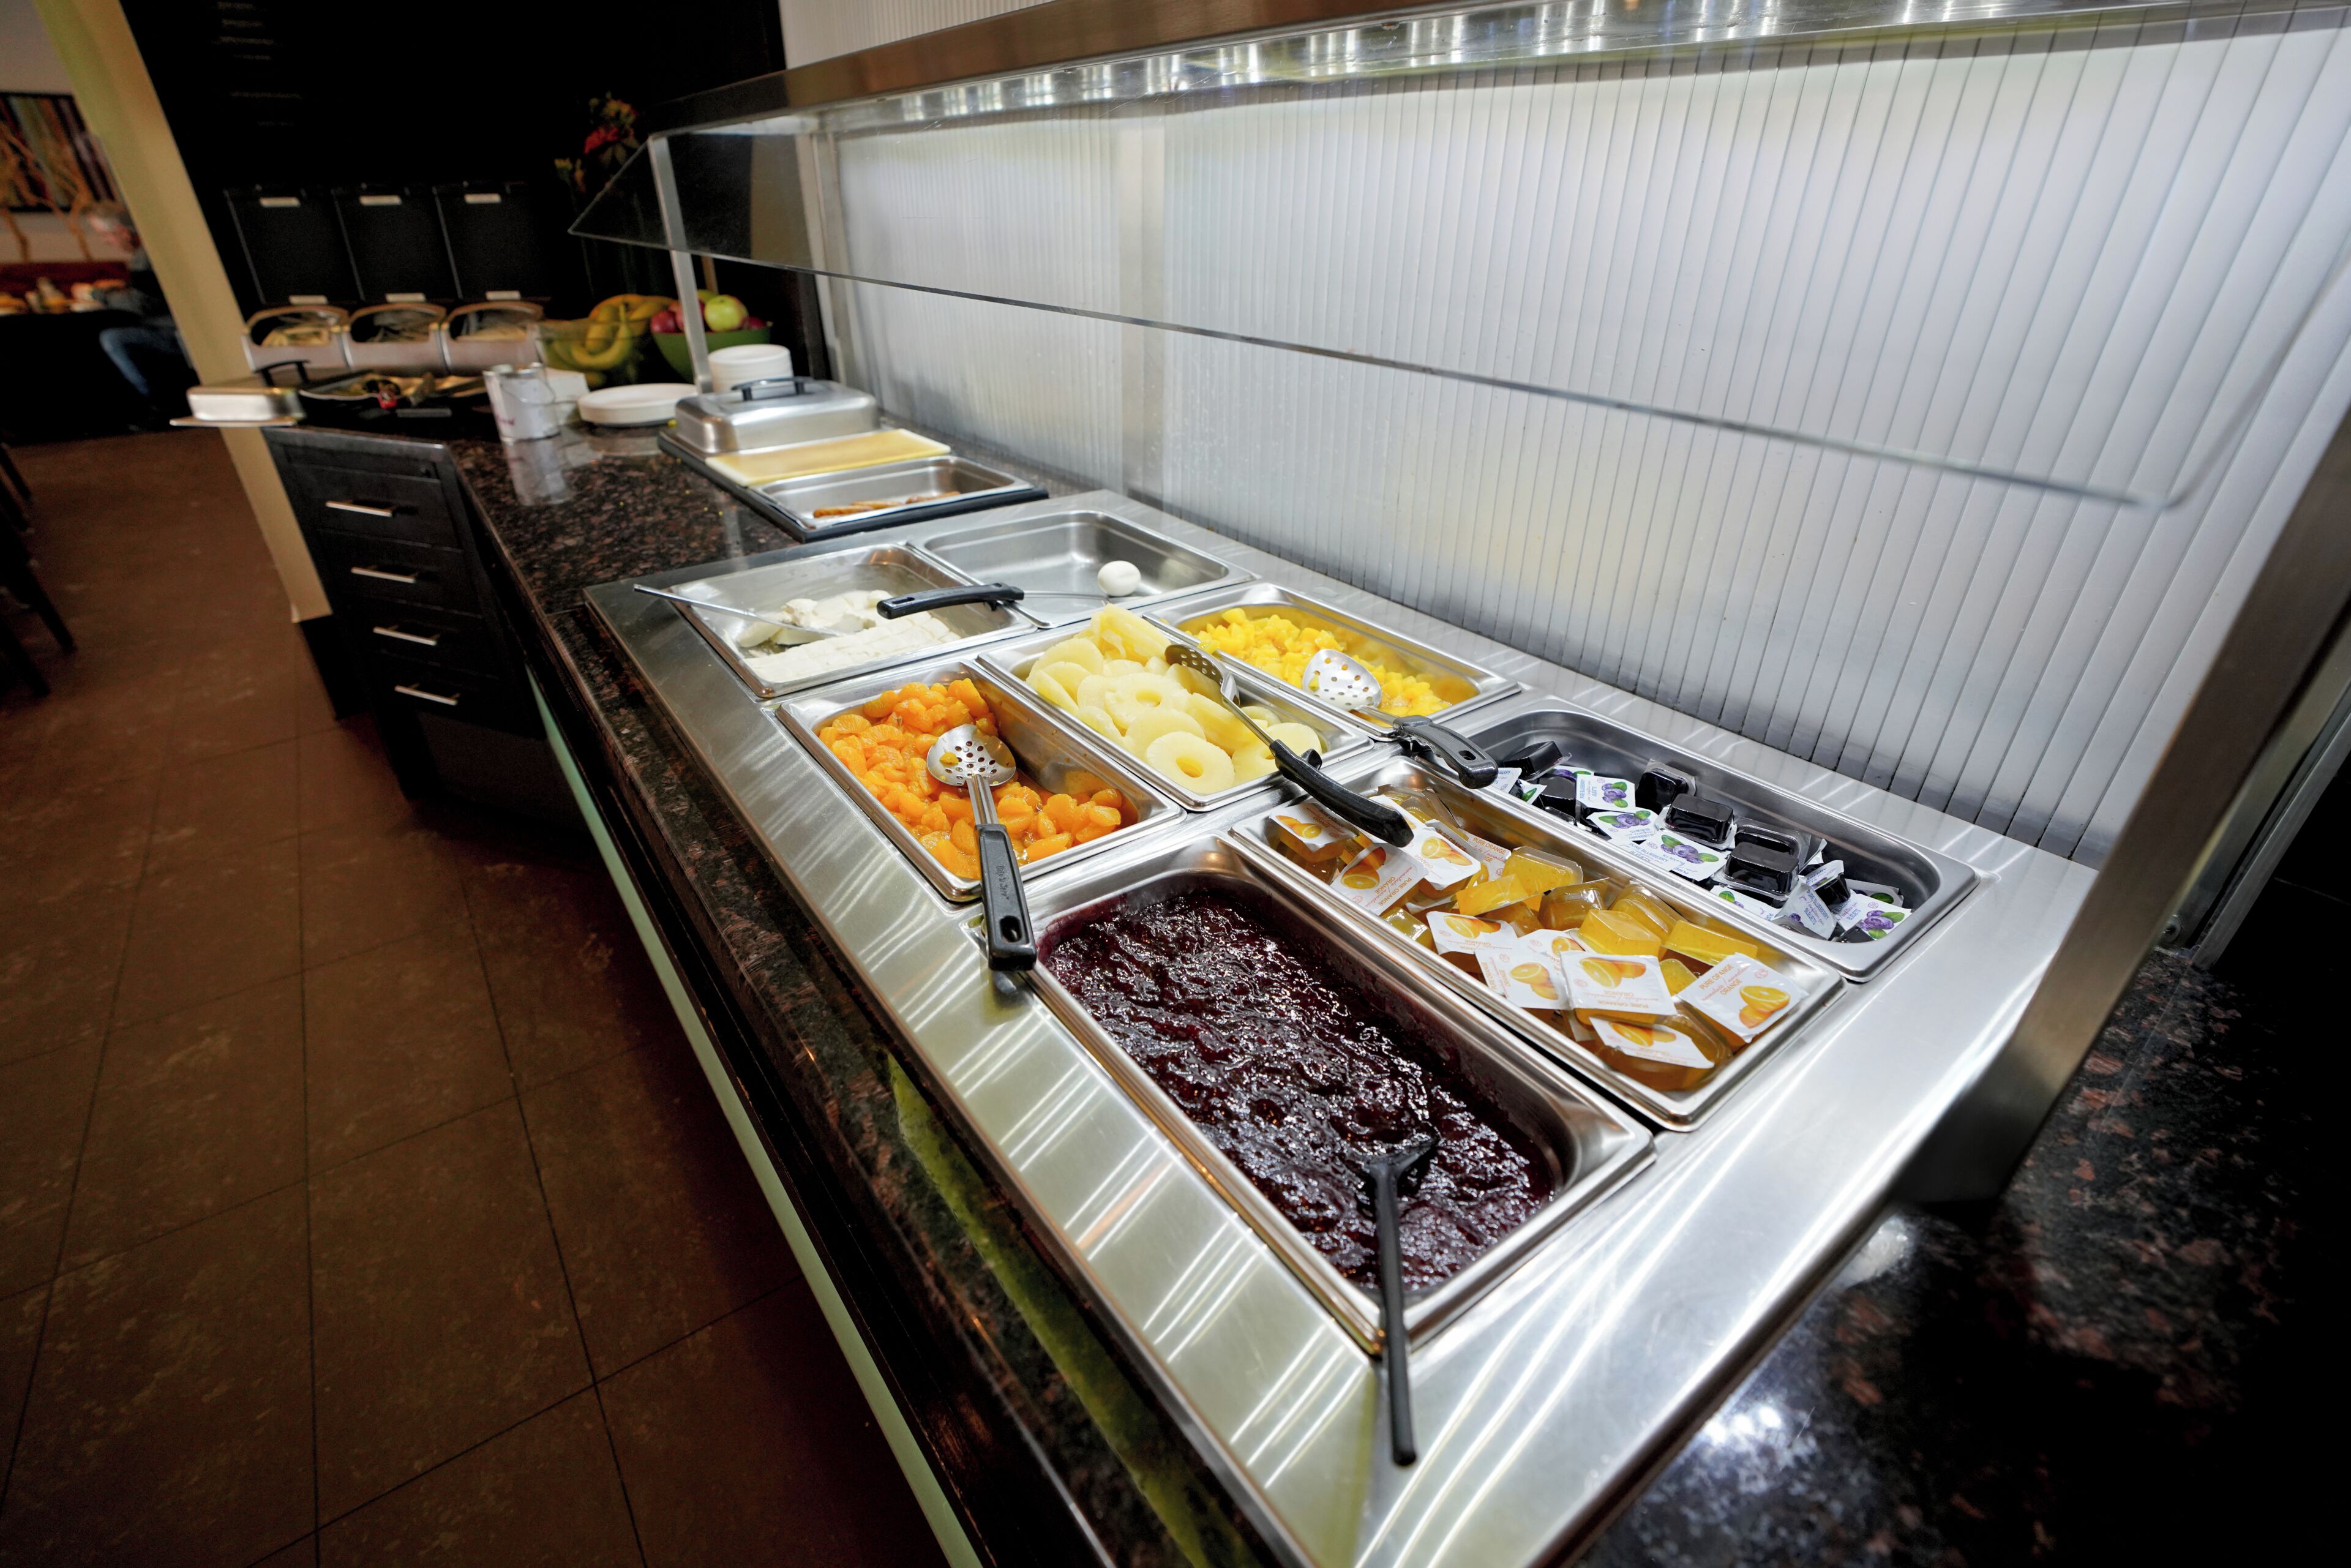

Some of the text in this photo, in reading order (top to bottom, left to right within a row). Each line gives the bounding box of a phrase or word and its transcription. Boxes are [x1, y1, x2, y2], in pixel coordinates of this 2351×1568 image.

[1472, 837, 1486, 846] PURE
[1485, 842, 1507, 855] ORANGE
[1374, 877, 1395, 895] ORANGE
[1378, 877, 1412, 906] PURE ORANGE
[1700, 964, 1734, 989] PURE ORANGE
[1720, 978, 1742, 996] ORANGE
